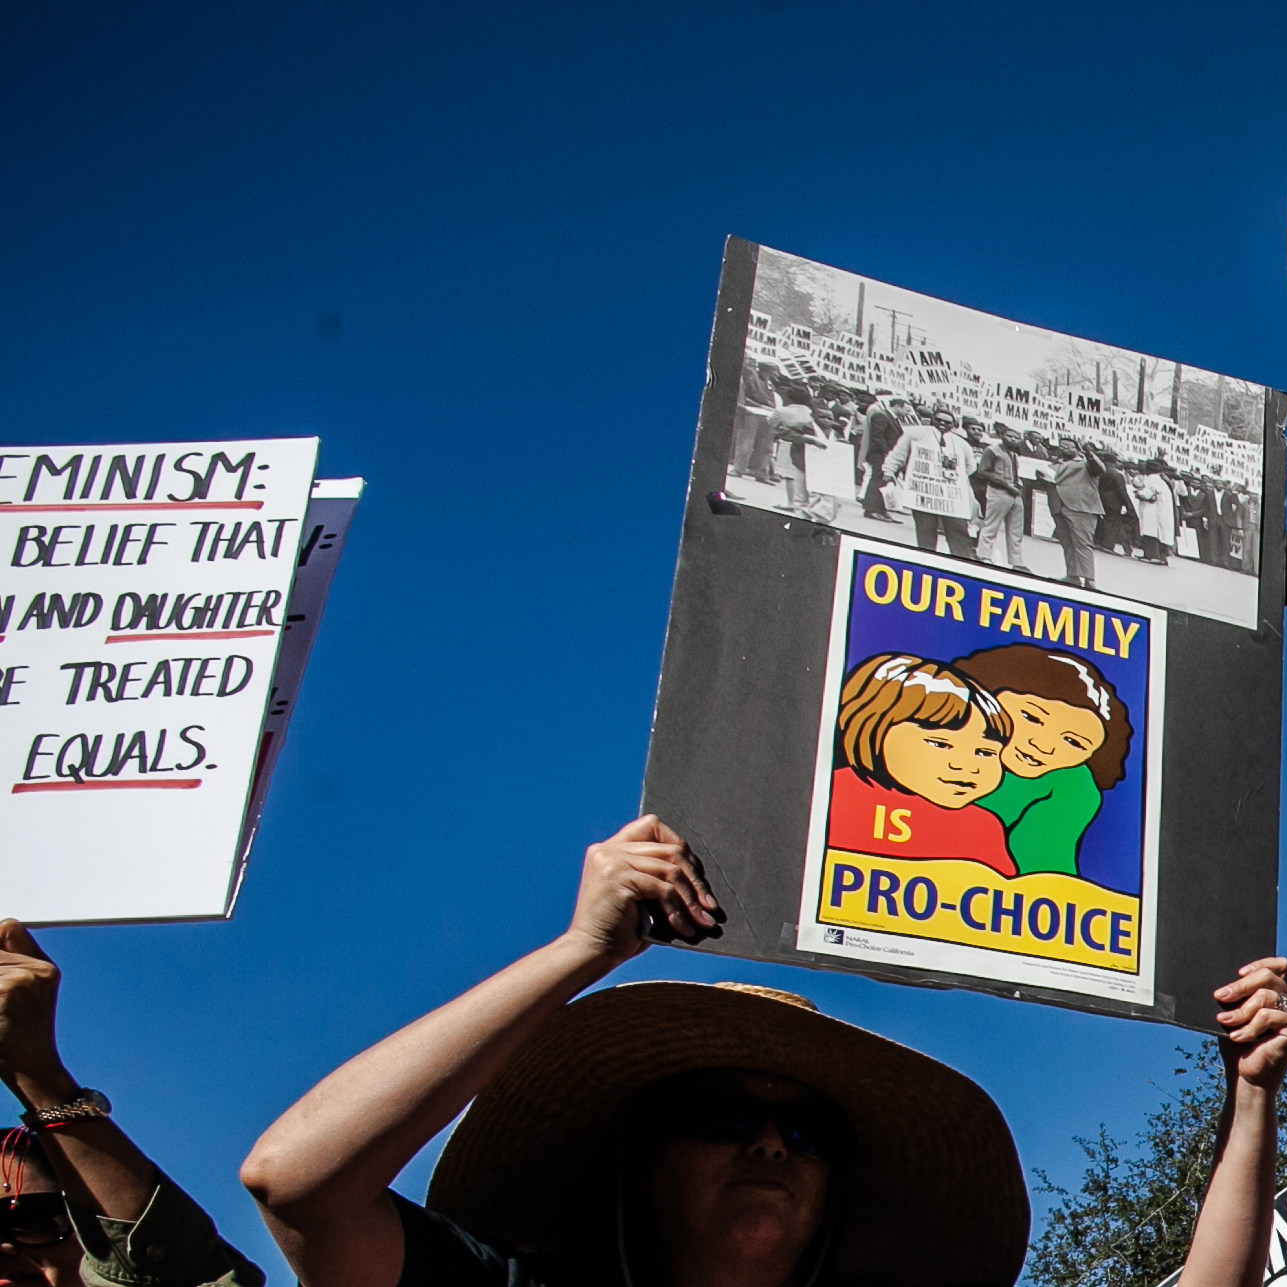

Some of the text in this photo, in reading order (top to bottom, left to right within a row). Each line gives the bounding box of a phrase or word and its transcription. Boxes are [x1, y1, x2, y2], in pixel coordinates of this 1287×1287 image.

[0, 453, 271, 504] EMINISM:
[10, 523, 178, 568] BELIEF
[190, 518, 299, 563] THAT
[17, 592, 104, 631] AND
[110, 589, 283, 632] DAUGHTER
[864, 563, 1141, 660] OUR FAMILY
[60, 655, 254, 706] TREATED
[22, 725, 218, 785] EQUALS.
[872, 803, 913, 843] IS
[828, 862, 1134, 958] PRO-CHOICE
